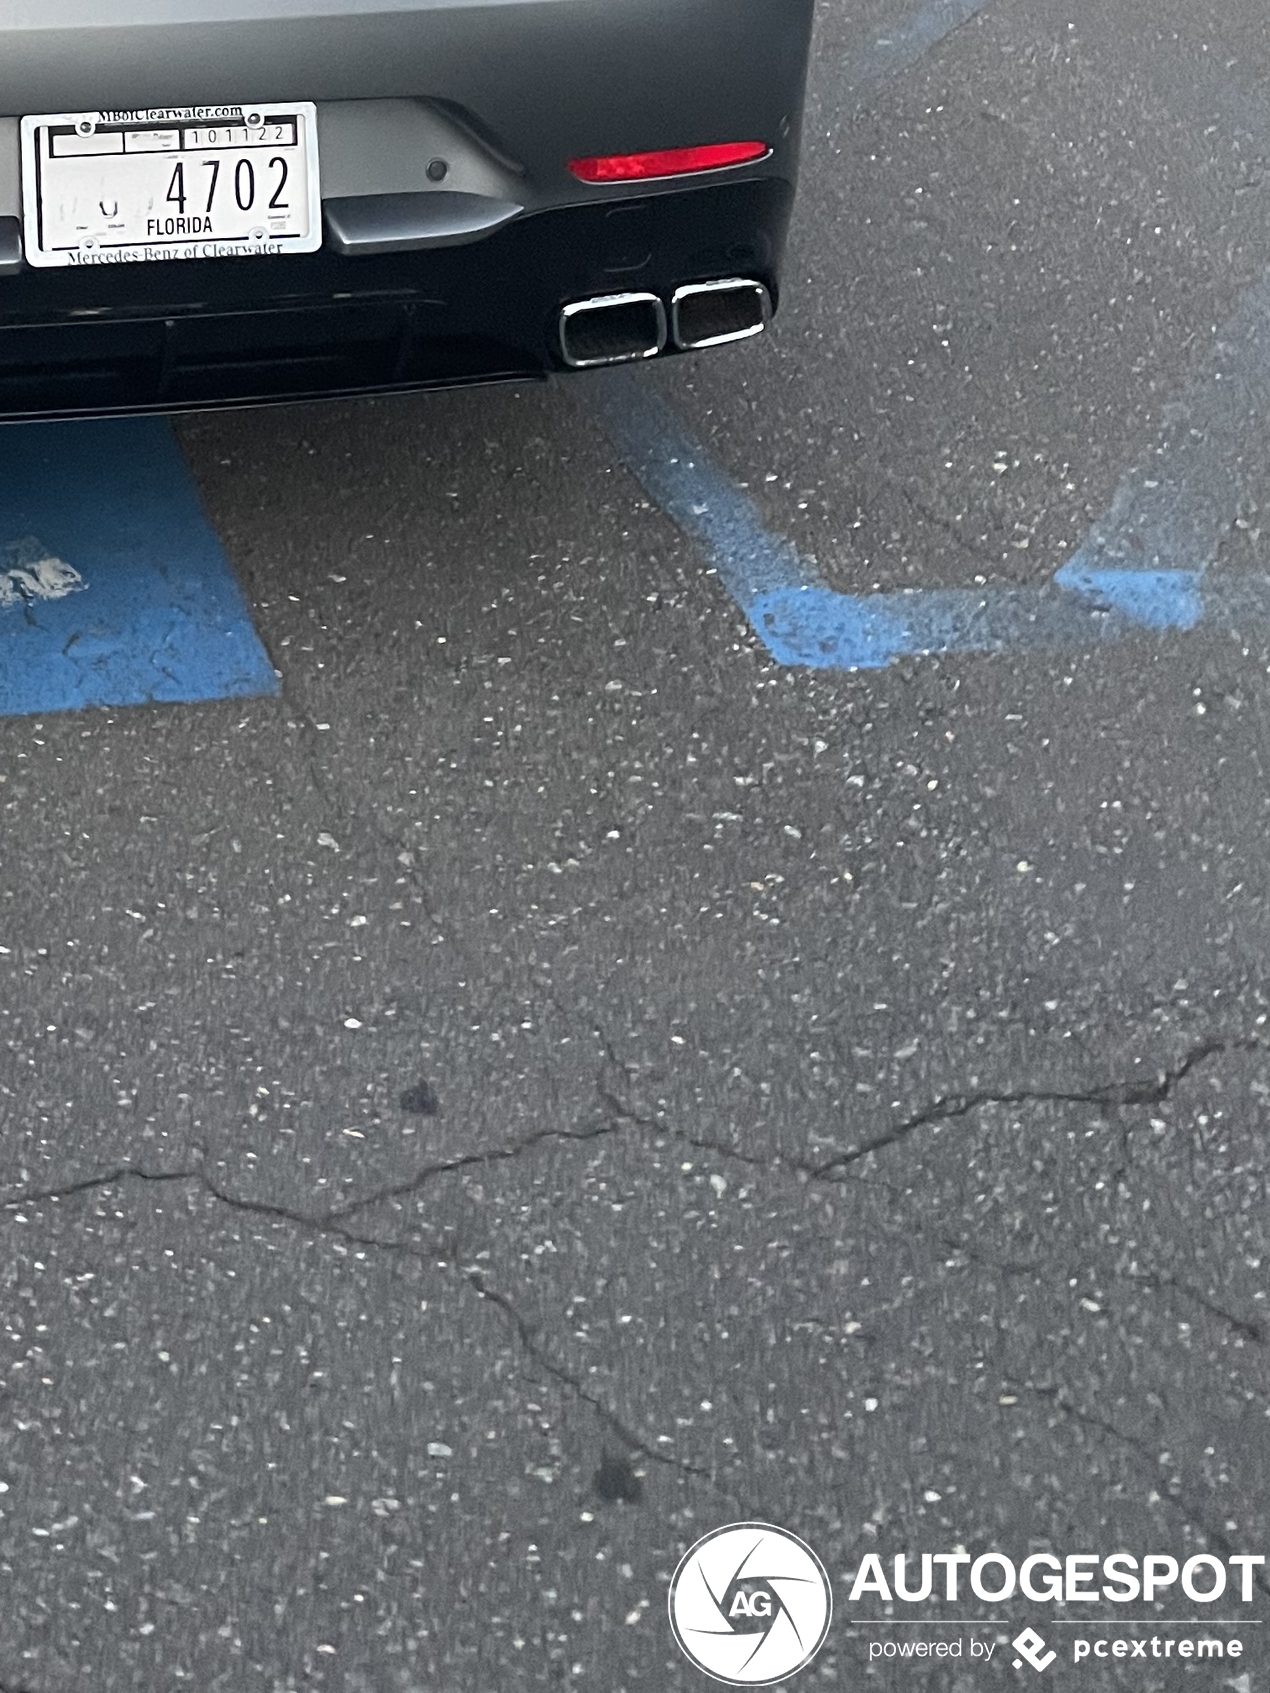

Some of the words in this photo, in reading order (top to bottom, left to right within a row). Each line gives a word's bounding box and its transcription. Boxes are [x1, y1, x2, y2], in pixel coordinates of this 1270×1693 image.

[147, 216, 213, 236] FLORIDA
[182, 244, 198, 259] of
[202, 243, 283, 257] Clearwater
